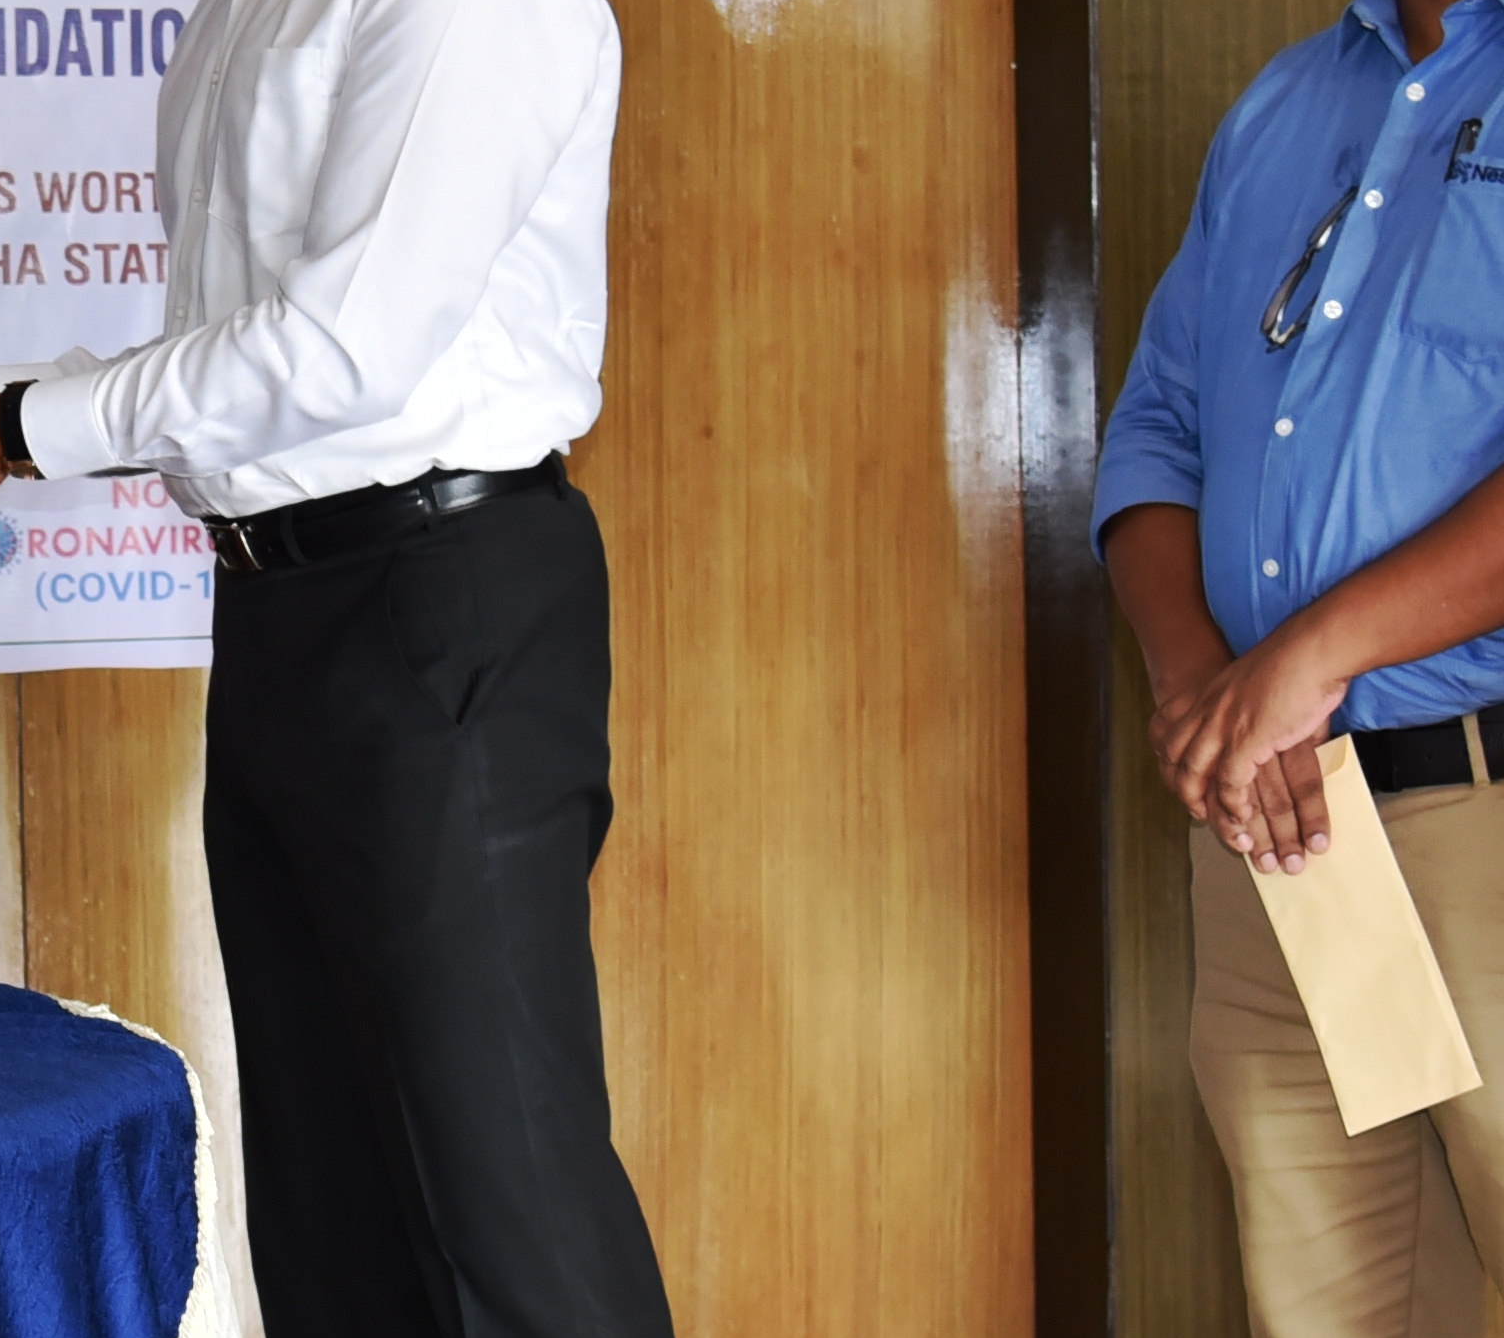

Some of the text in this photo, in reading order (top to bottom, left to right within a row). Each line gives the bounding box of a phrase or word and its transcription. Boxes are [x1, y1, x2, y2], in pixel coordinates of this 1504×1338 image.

[34, 171, 160, 214] WORT
[63, 242, 169, 286] STAT
[111, 479, 169, 510] NO
[35, 569, 211, 611] (COVID-1
